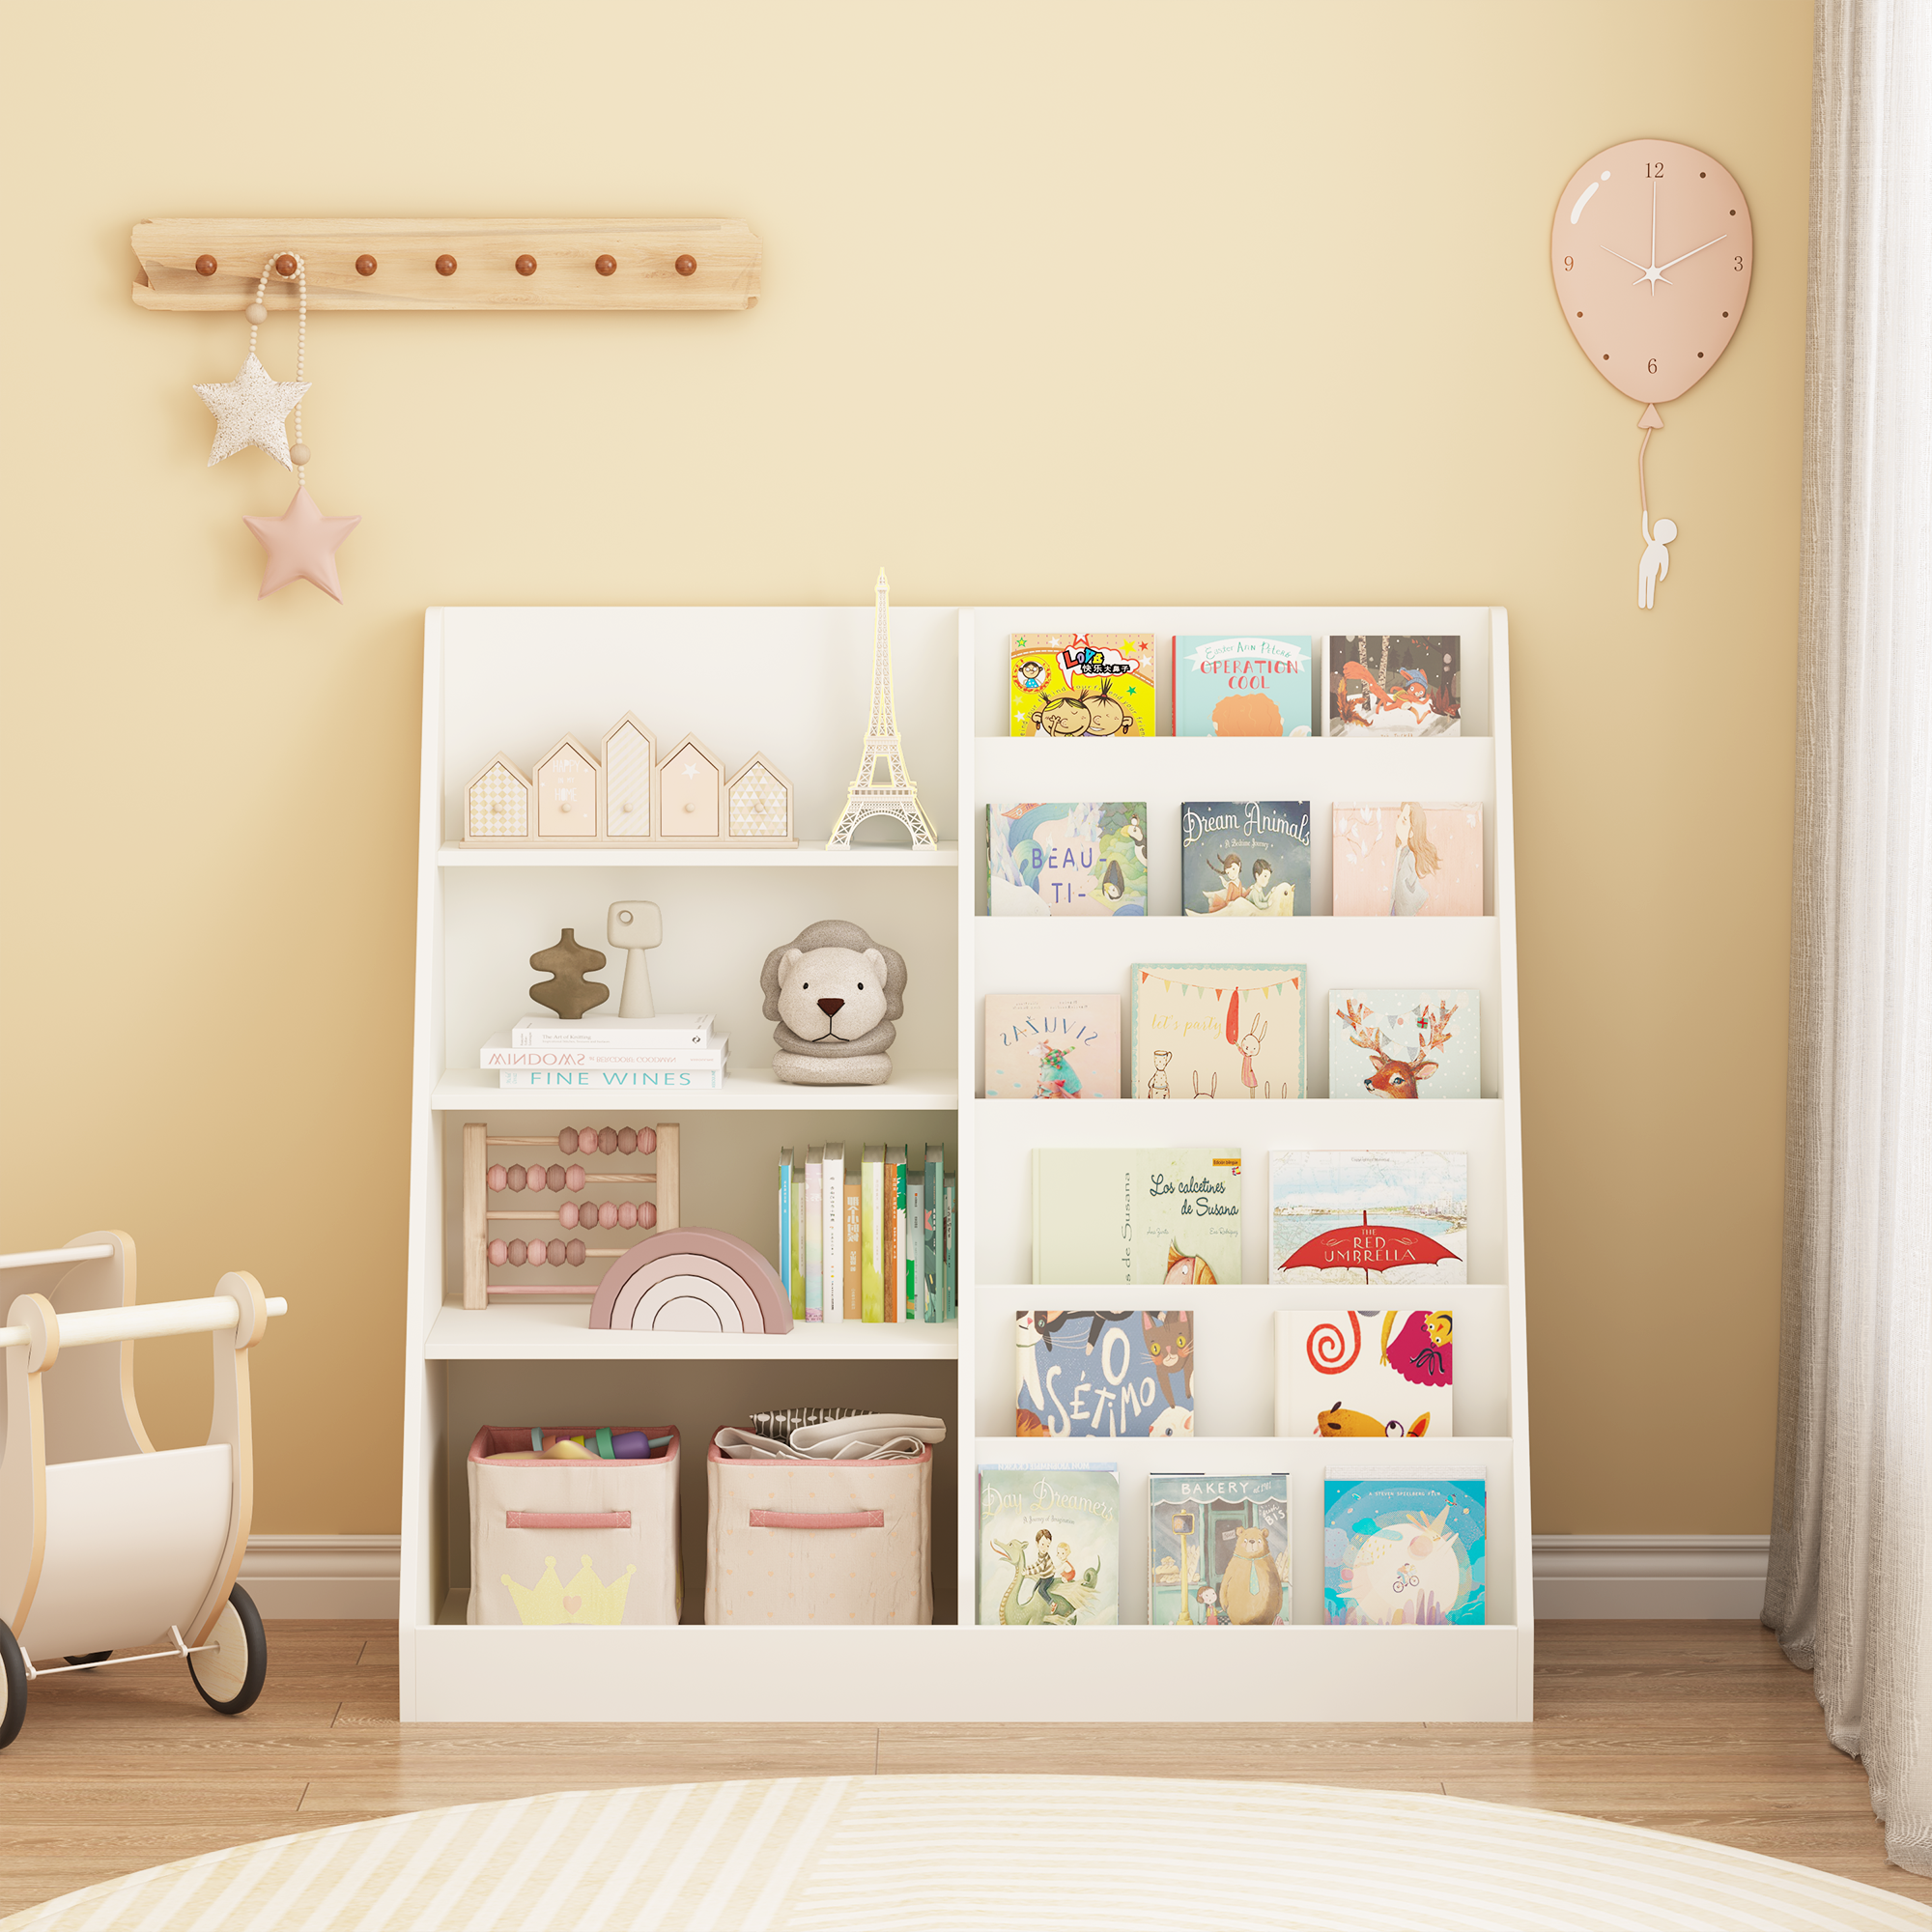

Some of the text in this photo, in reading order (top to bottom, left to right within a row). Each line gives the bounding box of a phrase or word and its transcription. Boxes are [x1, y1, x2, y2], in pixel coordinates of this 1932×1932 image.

[1645, 162, 1664, 179] 12
[1564, 256, 1574, 271] 9
[1734, 256, 1744, 271] 3
[1647, 358, 1657, 374] 6
[1082, 664, 1131, 674] 快乐大鼻子
[1200, 660, 1298, 674] OPERATION
[1228, 675, 1270, 690] COOL
[553, 759, 581, 772] HAPPY
[554, 788, 577, 801] HOME
[1183, 801, 1310, 847] Dream Animals
[1152, 1014, 1223, 1039] let's party
[531, 1072, 589, 1085] FINE
[603, 1073, 691, 1086] WINES
[1150, 1173, 1226, 1196] Los calcetines
[1121, 1173, 1132, 1241] Susana
[1181, 1197, 1239, 1216] de Susana
[1354, 1237, 1386, 1249] RED
[1122, 1247, 1131, 1268] de
[1324, 1249, 1416, 1264] UMBRELLA
[1101, 1327, 1131, 1386] O
[1181, 1482, 1249, 1495] BAKERY
[982, 1477, 1113, 1521] Day Dreamers
